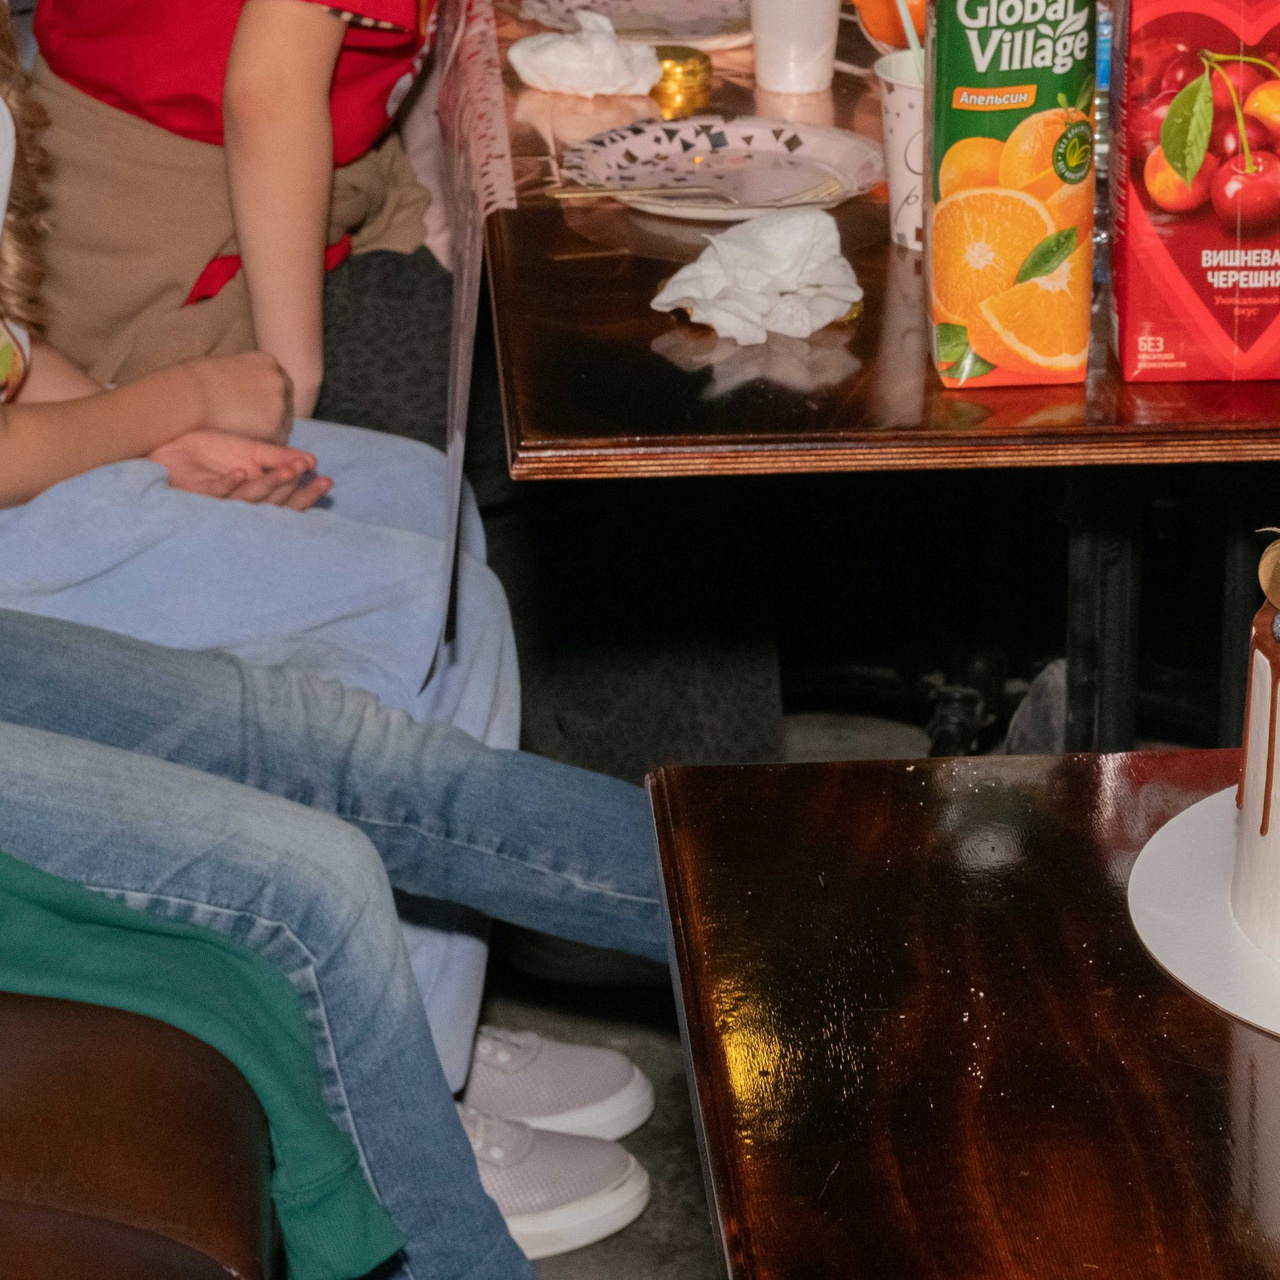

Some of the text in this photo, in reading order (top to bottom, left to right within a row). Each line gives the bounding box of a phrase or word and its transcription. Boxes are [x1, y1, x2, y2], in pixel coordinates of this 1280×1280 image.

[965, 27, 1089, 75] Village
[959, 91, 1028, 106] Апельсин
[1138, 337, 1164, 352] БЕЗ
